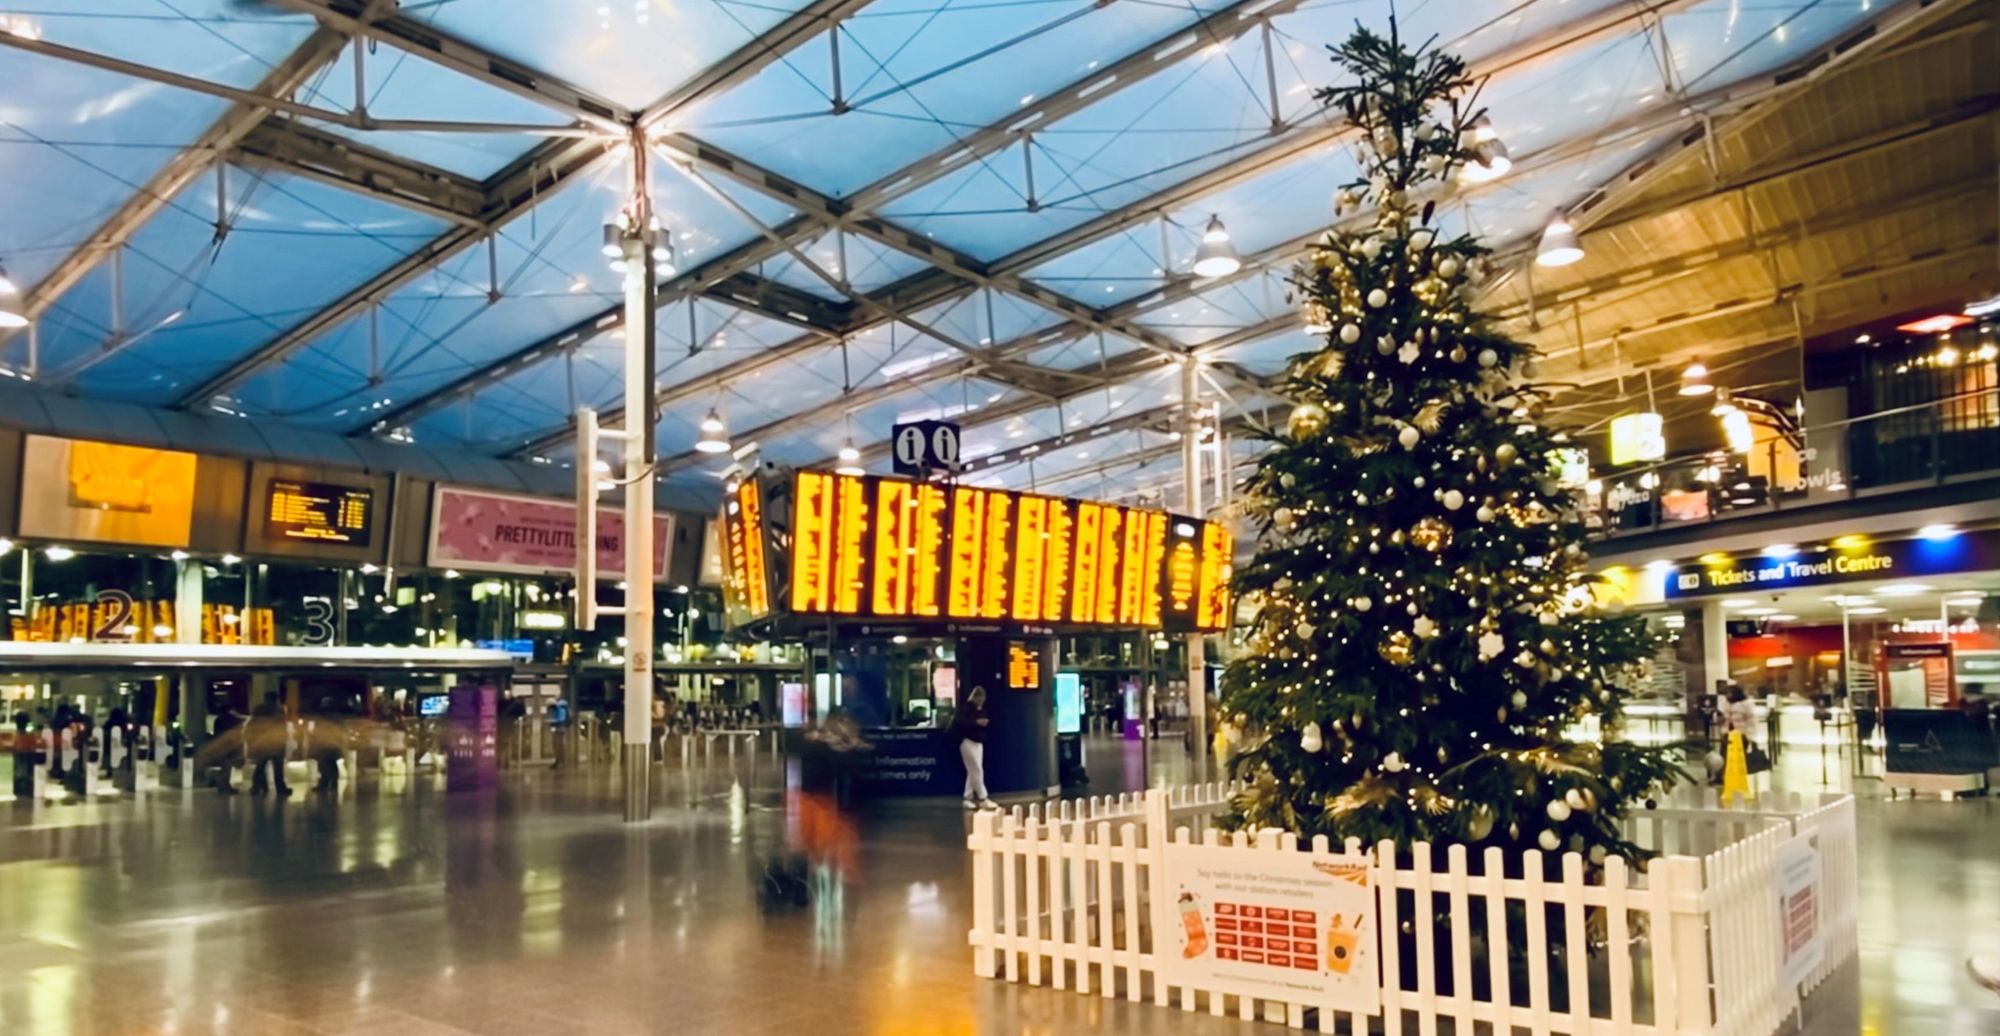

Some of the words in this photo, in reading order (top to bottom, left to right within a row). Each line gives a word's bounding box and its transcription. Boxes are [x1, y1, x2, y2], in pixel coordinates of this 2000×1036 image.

[1708, 569, 1756, 587] Tickets
[1758, 564, 1784, 581] and
[1789, 558, 1832, 577] Travel
[1835, 555, 1893, 573] Centre
[94, 589, 134, 641] 2
[302, 599, 335, 646] 3
[908, 769, 932, 782] only
[1259, 873, 1302, 885] Christmas
